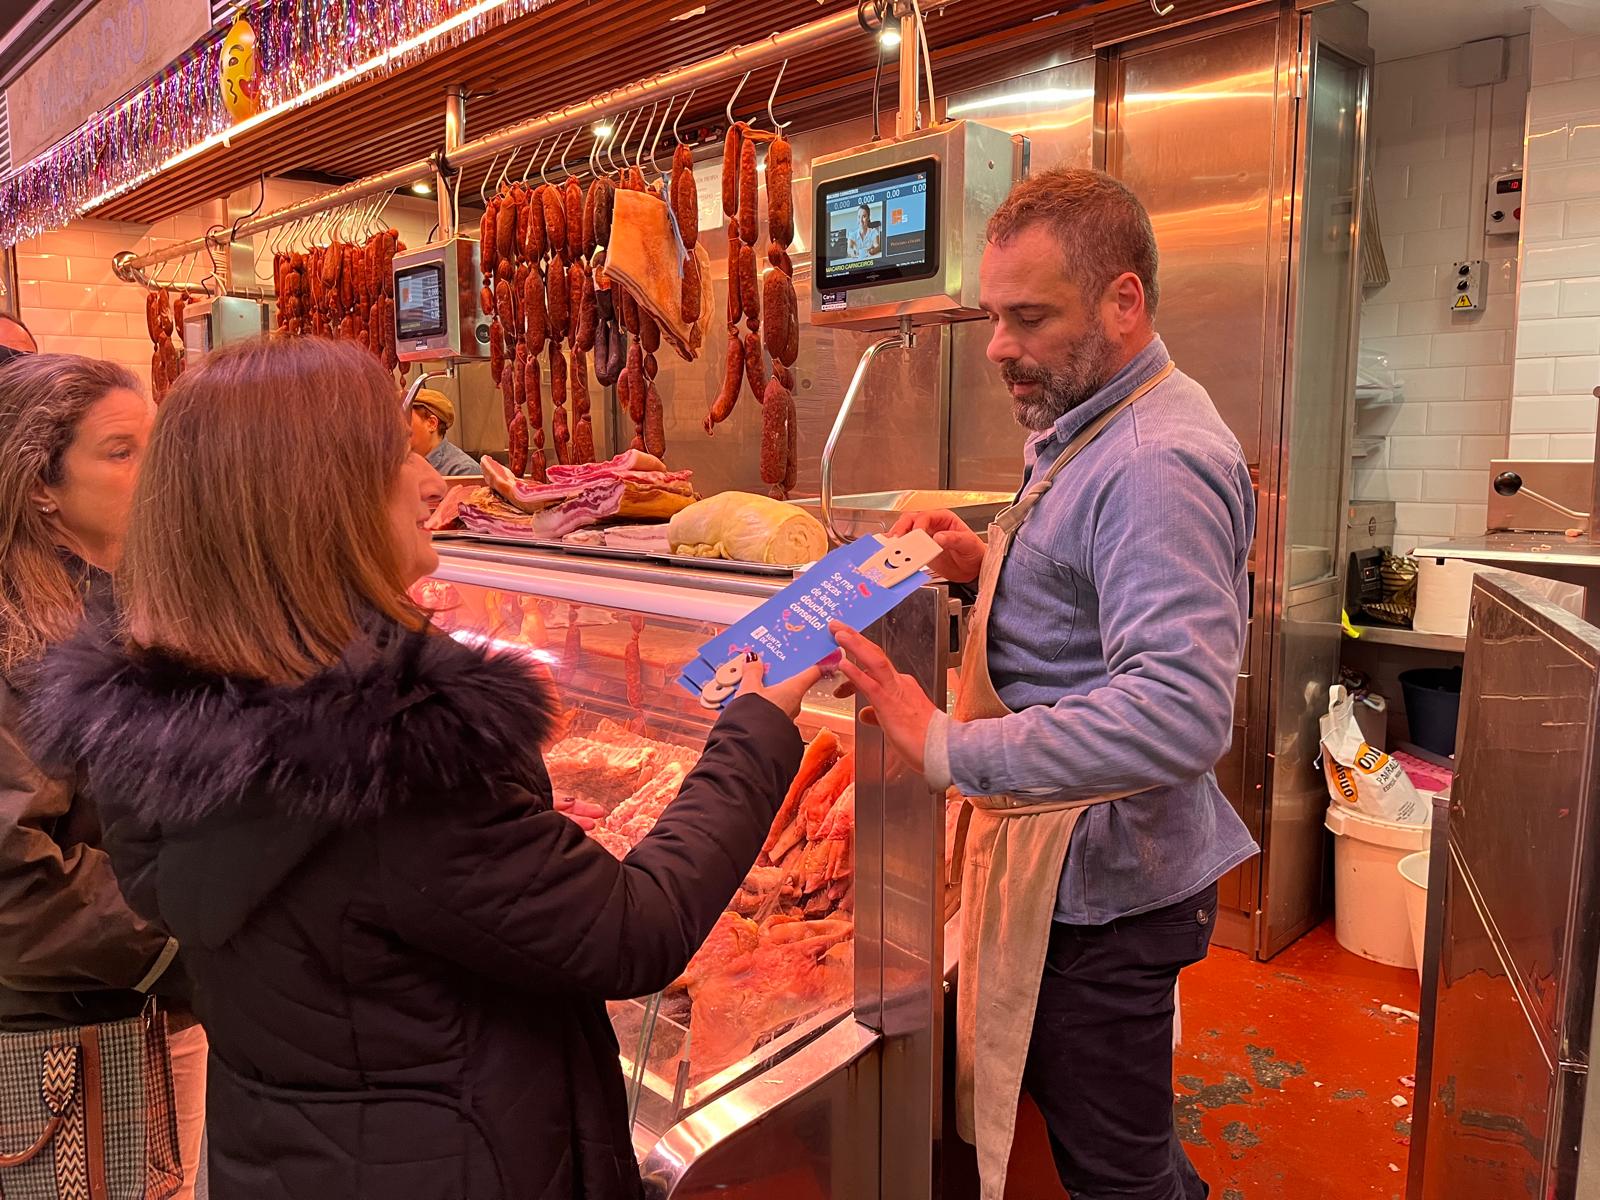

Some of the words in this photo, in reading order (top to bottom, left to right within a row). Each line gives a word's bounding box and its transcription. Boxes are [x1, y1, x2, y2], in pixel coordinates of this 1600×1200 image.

[38, 0, 148, 133] MACARIO
[821, 580, 842, 596] sacas
[831, 572, 842, 582] Se
[840, 579, 854, 590] me
[800, 594, 828, 618] douche
[811, 588, 822, 597] de
[820, 594, 840, 611] aquí,
[790, 603, 826, 631] consello!
[759, 636, 768, 645] DE
[766, 642, 786, 661] GALICIA
[765, 633, 782, 649] XUNTA
